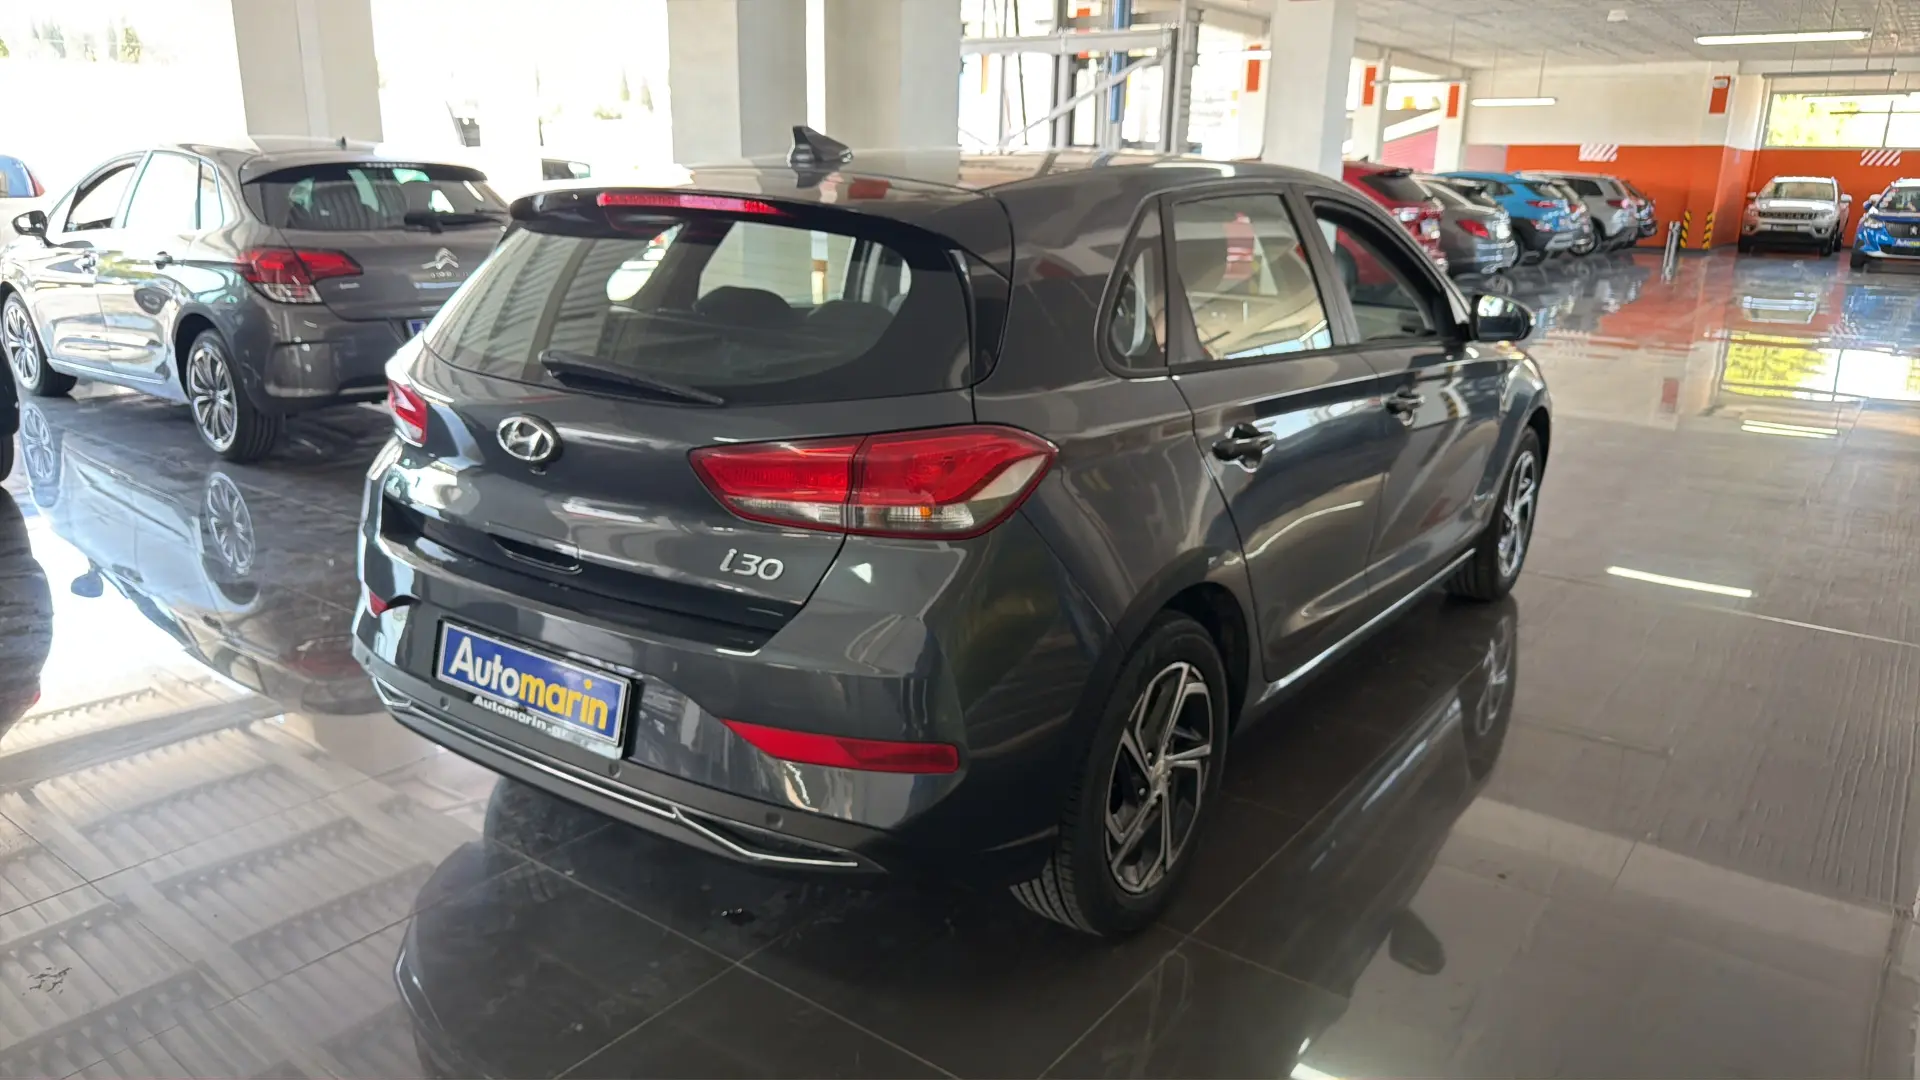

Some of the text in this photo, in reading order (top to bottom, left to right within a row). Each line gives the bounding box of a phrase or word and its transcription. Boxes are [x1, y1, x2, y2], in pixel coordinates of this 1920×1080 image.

[719, 548, 784, 581] i30
[449, 636, 608, 730] Automarin
[472, 695, 569, 738] Automarin.gr
